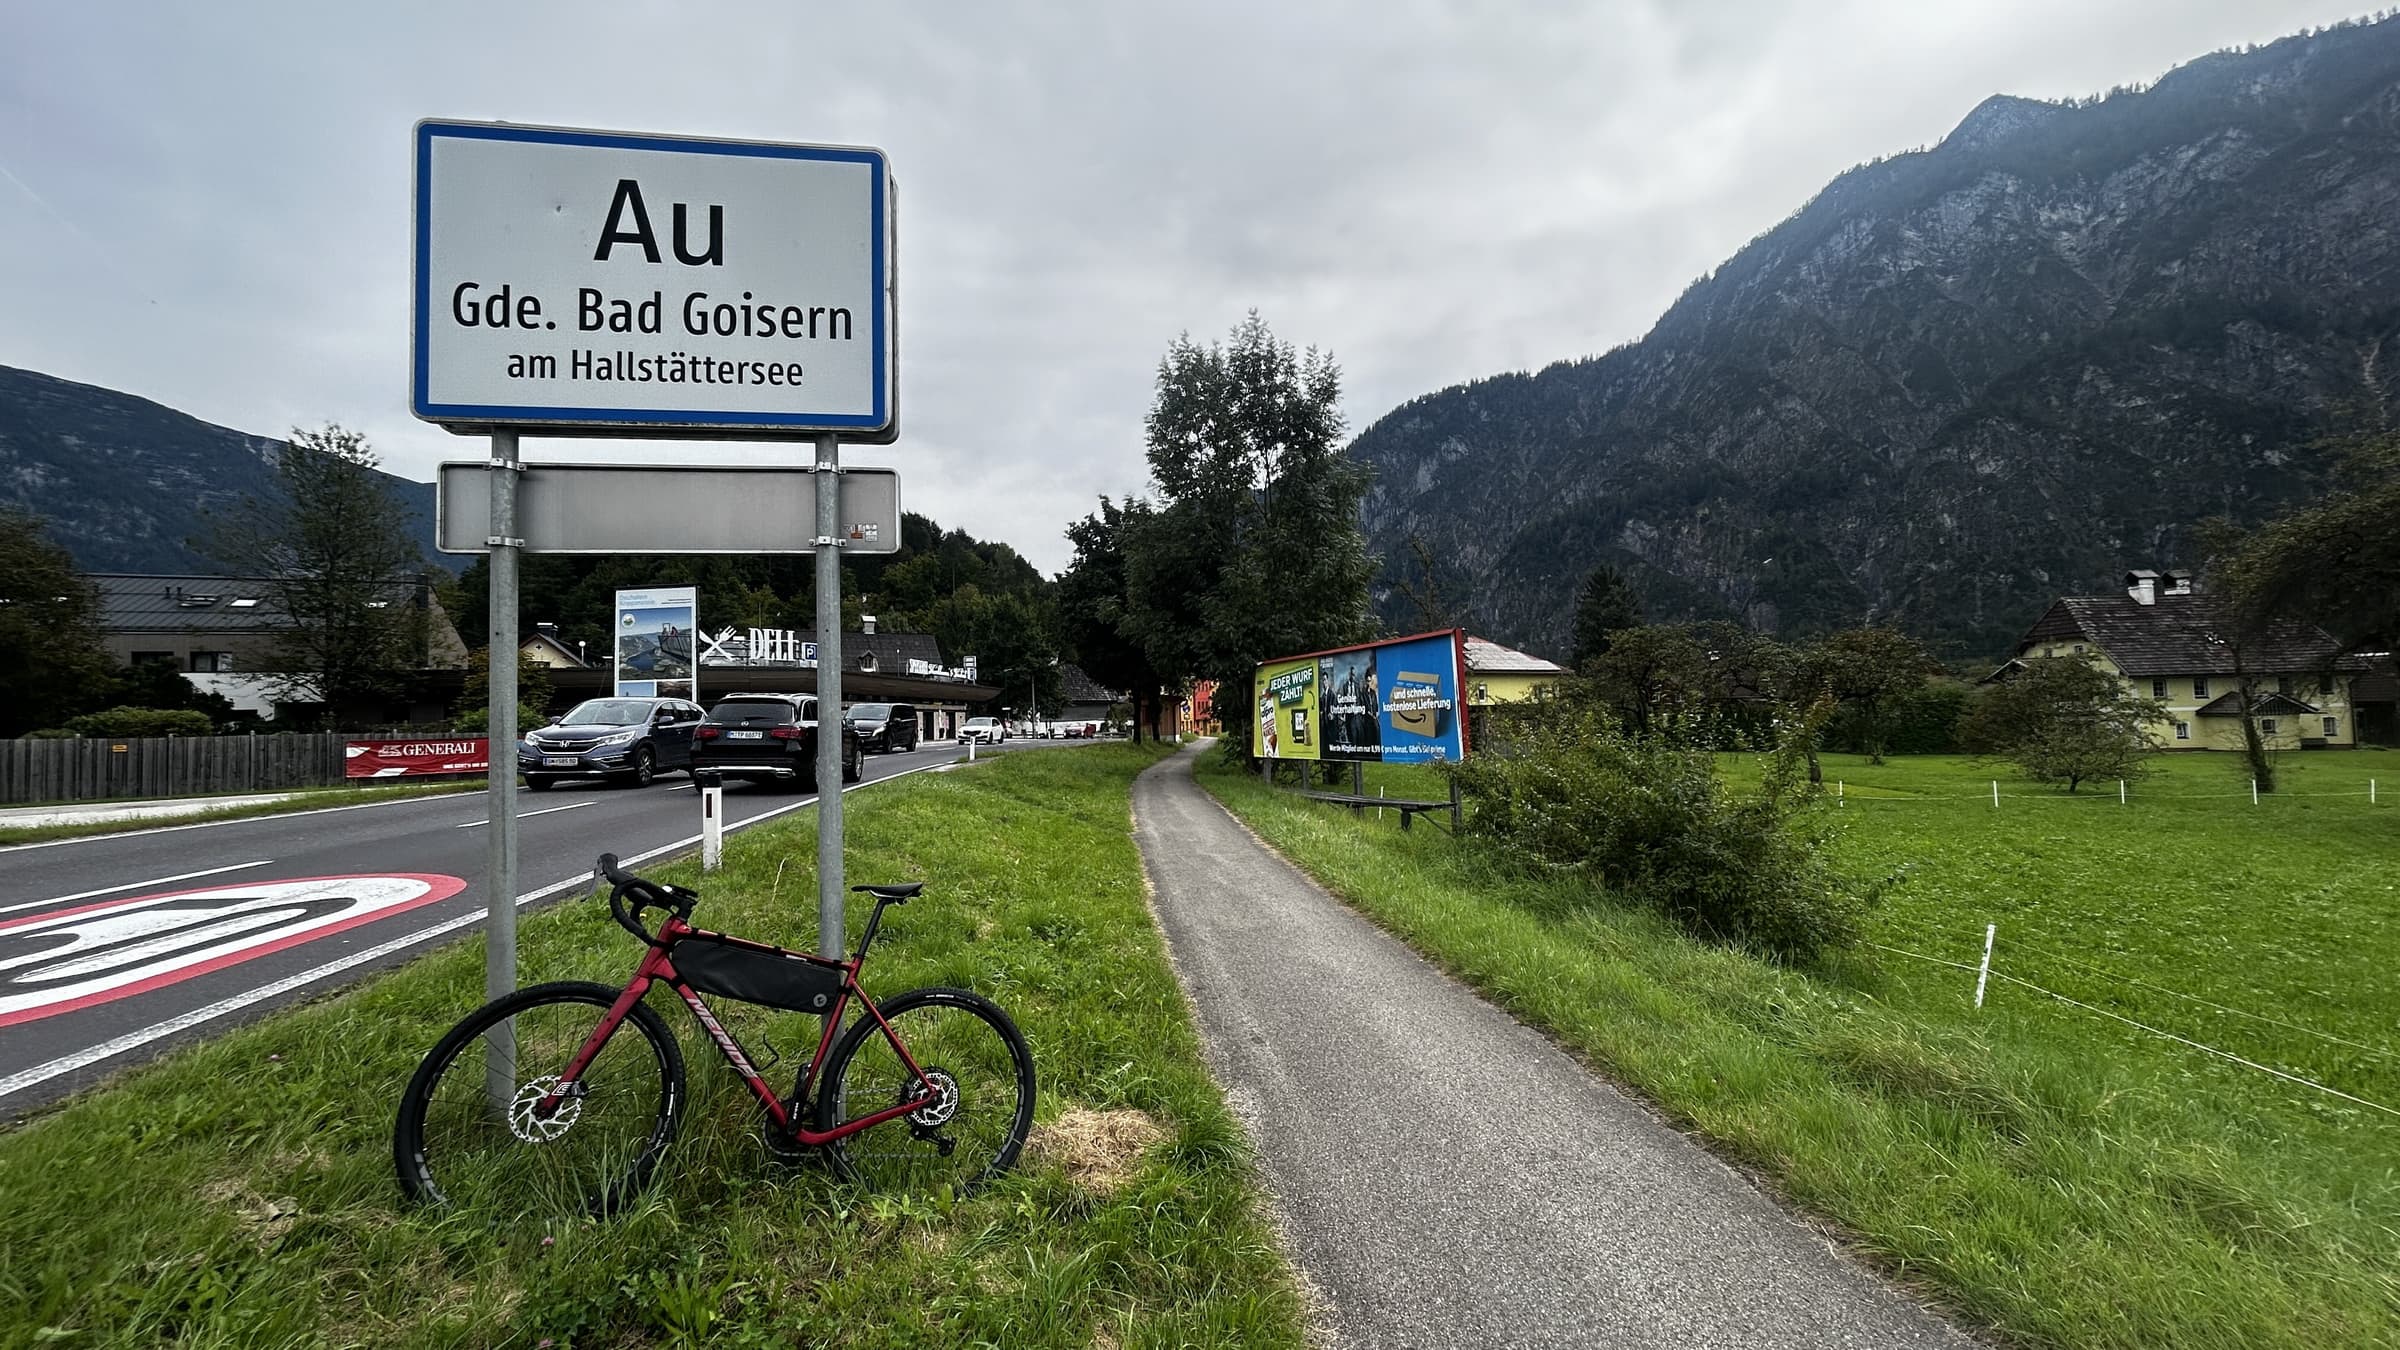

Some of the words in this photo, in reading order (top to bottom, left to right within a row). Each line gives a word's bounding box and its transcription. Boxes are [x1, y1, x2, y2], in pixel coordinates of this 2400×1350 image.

[593, 178, 724, 267] Au
[452, 282, 556, 331] Gde.
[578, 287, 662, 334] Bad
[682, 291, 853, 341] Goisern
[507, 351, 557, 380] am
[571, 349, 804, 387] Hallstättersee
[748, 627, 796, 661] DELI
[1270, 676, 1291, 690] JEDER
[1292, 668, 1313, 684] WURF
[1280, 685, 1303, 701] ZÄHLT!
[1393, 688, 1406, 699] und
[1406, 685, 1436, 698] schnelle,
[1330, 705, 1366, 715] Unterhaltung
[1382, 700, 1416, 712] kostenlose
[1417, 698, 1451, 710] Lieferung
[403, 742, 476, 756] GENERALI
[686, 998, 759, 1078] MERIDA
